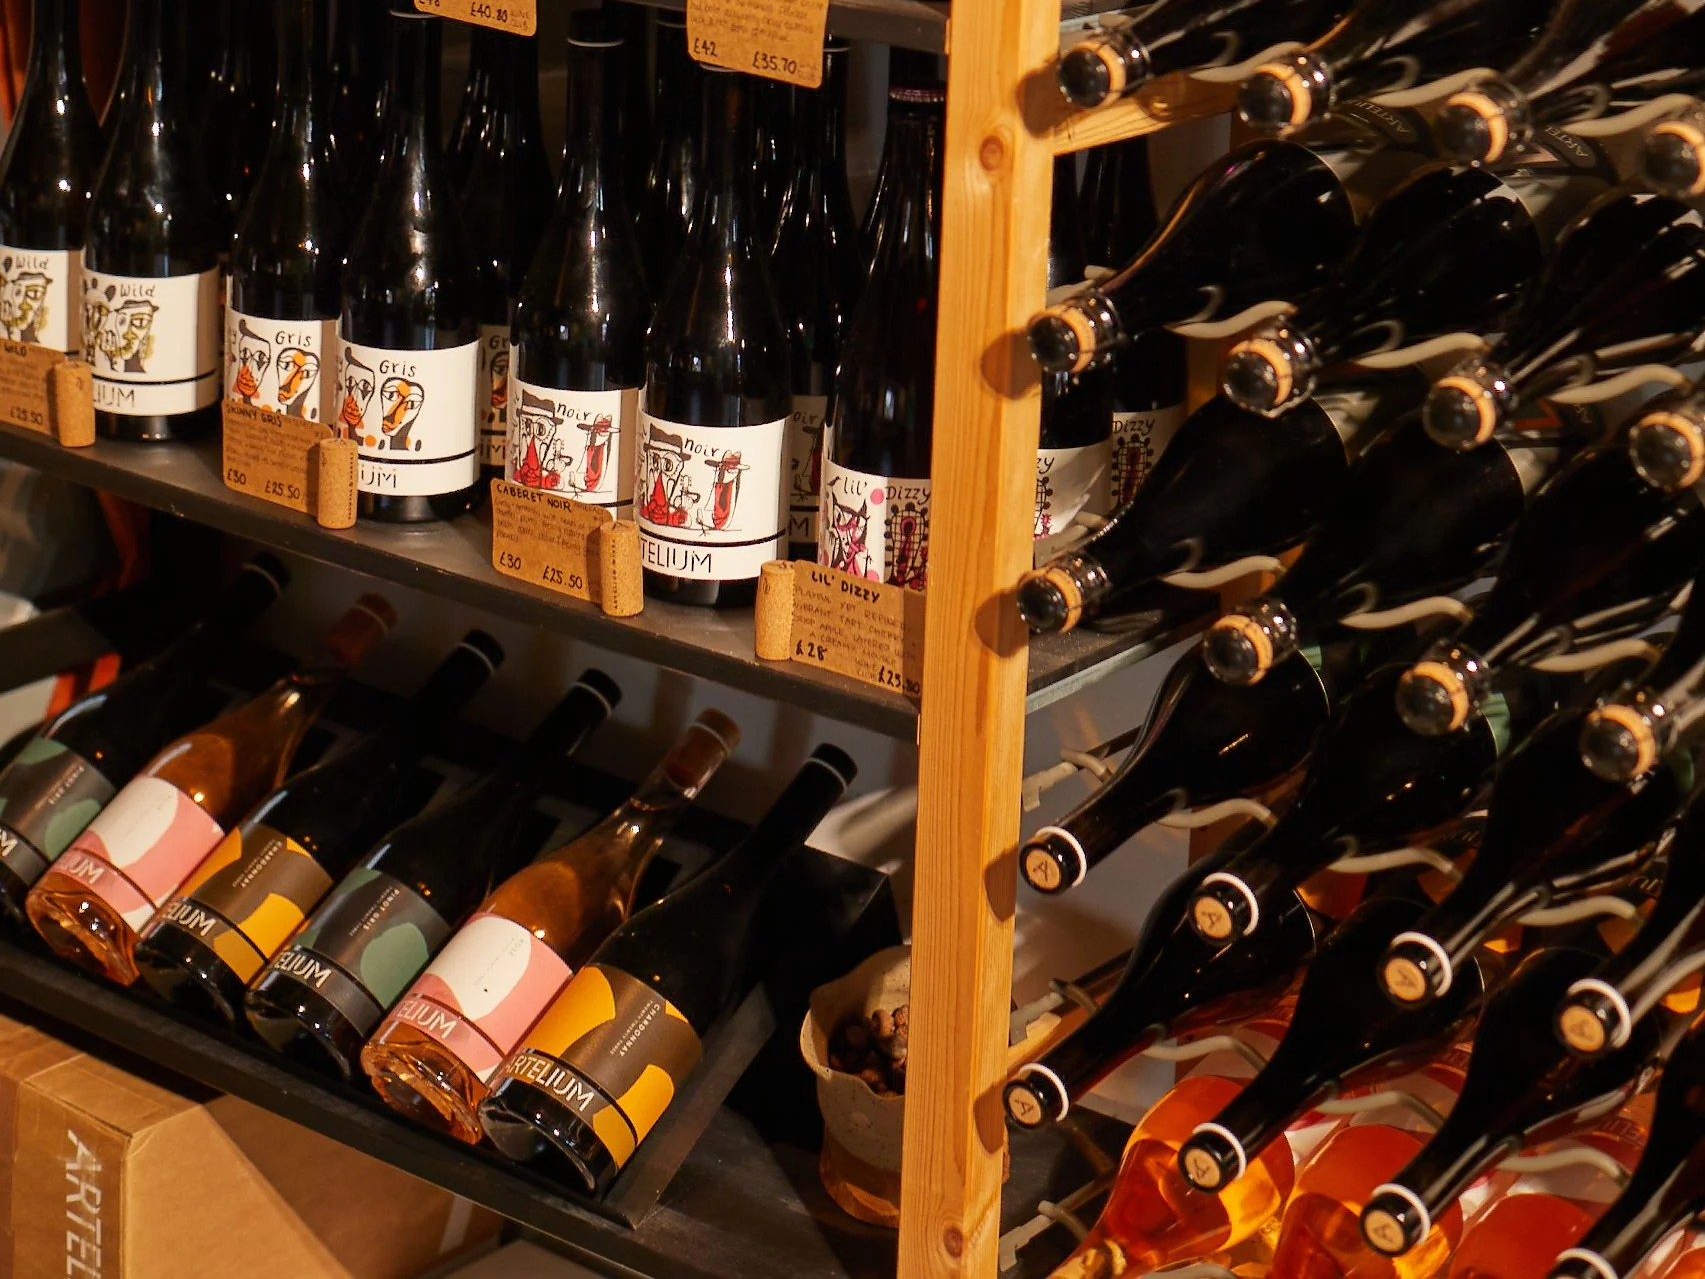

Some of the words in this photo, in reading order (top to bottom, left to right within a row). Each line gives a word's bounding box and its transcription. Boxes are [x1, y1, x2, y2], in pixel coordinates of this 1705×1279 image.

[470, 2, 508, 23] £40.80
[693, 37, 719, 58] £42
[752, 51, 797, 74] £35.70
[15, 256, 50, 271] Wild
[119, 284, 156, 298] Wild
[275, 330, 313, 348] Gris
[379, 359, 418, 379] Gris
[226, 404, 258, 420] SKINNY
[261, 410, 282, 428] GRIS
[556, 402, 594, 422] noir
[1113, 417, 1156, 437] Dizzy
[683, 437, 721, 458] noir
[227, 468, 247, 486] £30
[264, 480, 301, 500] £25.50
[496, 483, 545, 503] CABERET
[547, 497, 573, 514] NOIR
[885, 485, 931, 506] Dizzy
[640, 538, 713, 574] TELIUM
[499, 551, 522, 570] £30
[542, 565, 584, 590] £25.50
[811, 571, 835, 587] LIL'
[841, 580, 880, 604] DIZZY
[795, 640, 828, 662] £28
[240, 841, 284, 890] CHARDONNAY
[379, 887, 401, 913] PINOT
[363, 912, 381, 932] GRIS
[619, 1003, 661, 1058] CHARDONNAY
